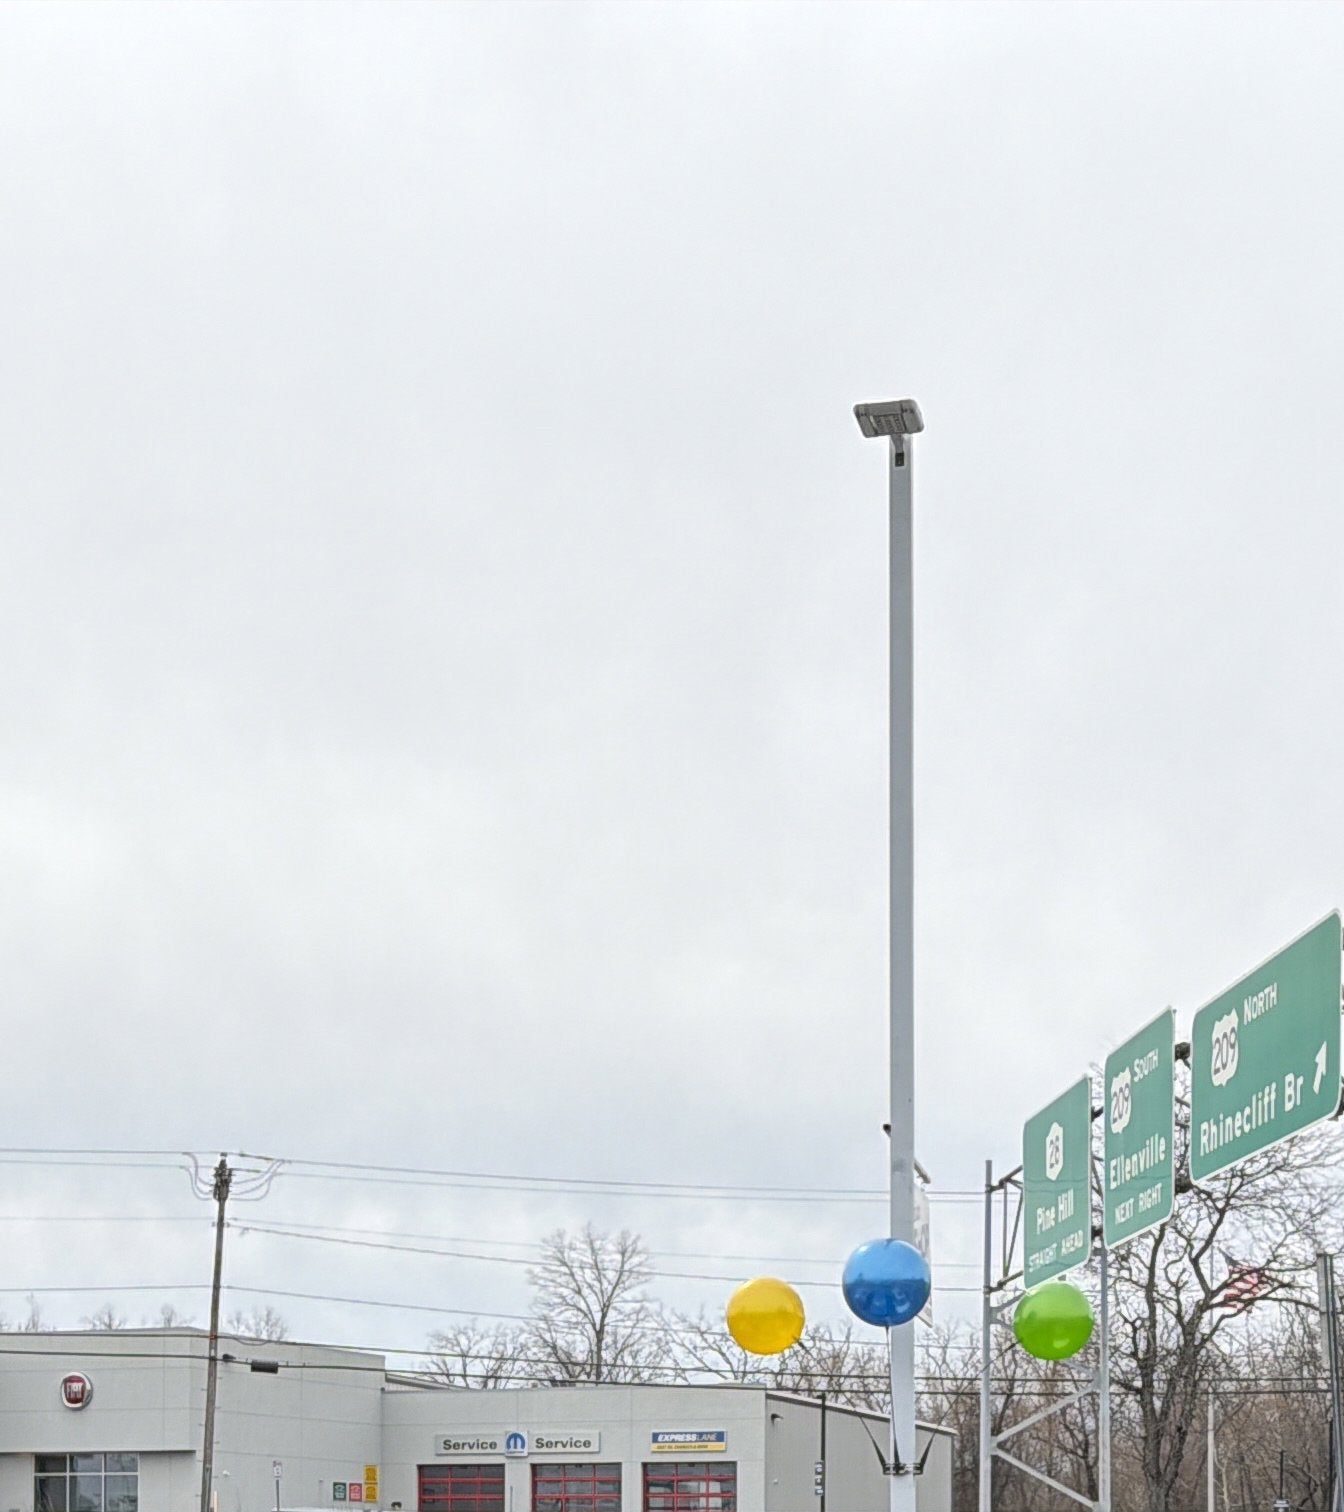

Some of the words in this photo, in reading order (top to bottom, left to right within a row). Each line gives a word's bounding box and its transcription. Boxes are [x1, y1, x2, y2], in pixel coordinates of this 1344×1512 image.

[1244, 983, 1277, 1025] NORTH
[1133, 1049, 1158, 1082] SOUTH
[1213, 1027, 1237, 1075] 209
[1112, 1083, 1130, 1124] 209
[1200, 1082, 1276, 1156] Rhinecliff
[1284, 1072, 1304, 1112] Br
[1109, 1133, 1166, 1190] Ellenville
[1036, 1206, 1055, 1235] Pine
[1058, 1188, 1074, 1223] Hill
[1115, 1198, 1134, 1225] NEXT
[1138, 1182, 1162, 1213] RIGHT
[1029, 1243, 1057, 1273] STRAIGHT
[1061, 1229, 1084, 1256] AHEAD
[442, 1438, 498, 1451] Service
[535, 1437, 592, 1449] Service
